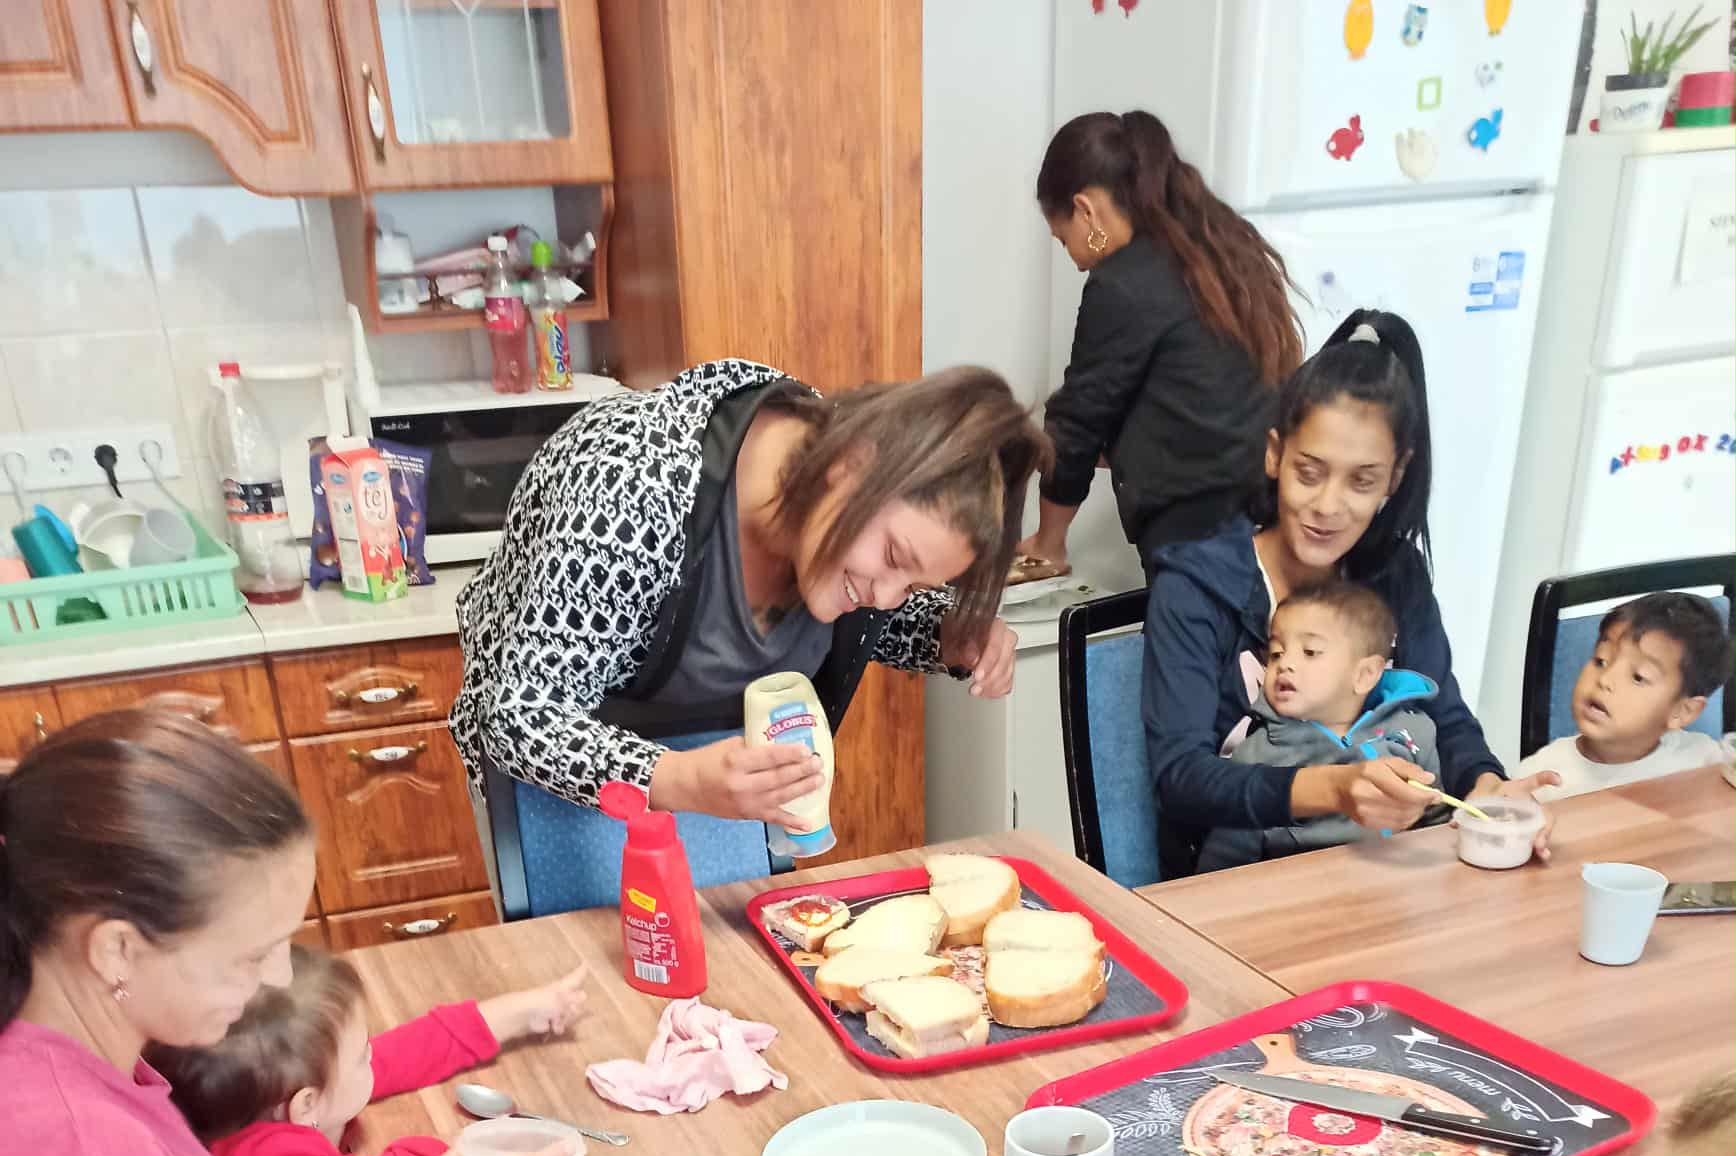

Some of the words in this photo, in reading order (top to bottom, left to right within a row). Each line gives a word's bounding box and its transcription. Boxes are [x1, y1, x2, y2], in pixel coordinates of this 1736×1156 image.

[552, 325, 567, 374] play
[364, 487, 388, 520] tej
[768, 714, 814, 735] GLOBUS
[625, 914, 657, 931] Ketchup
[1449, 1070, 1502, 1096] menu
